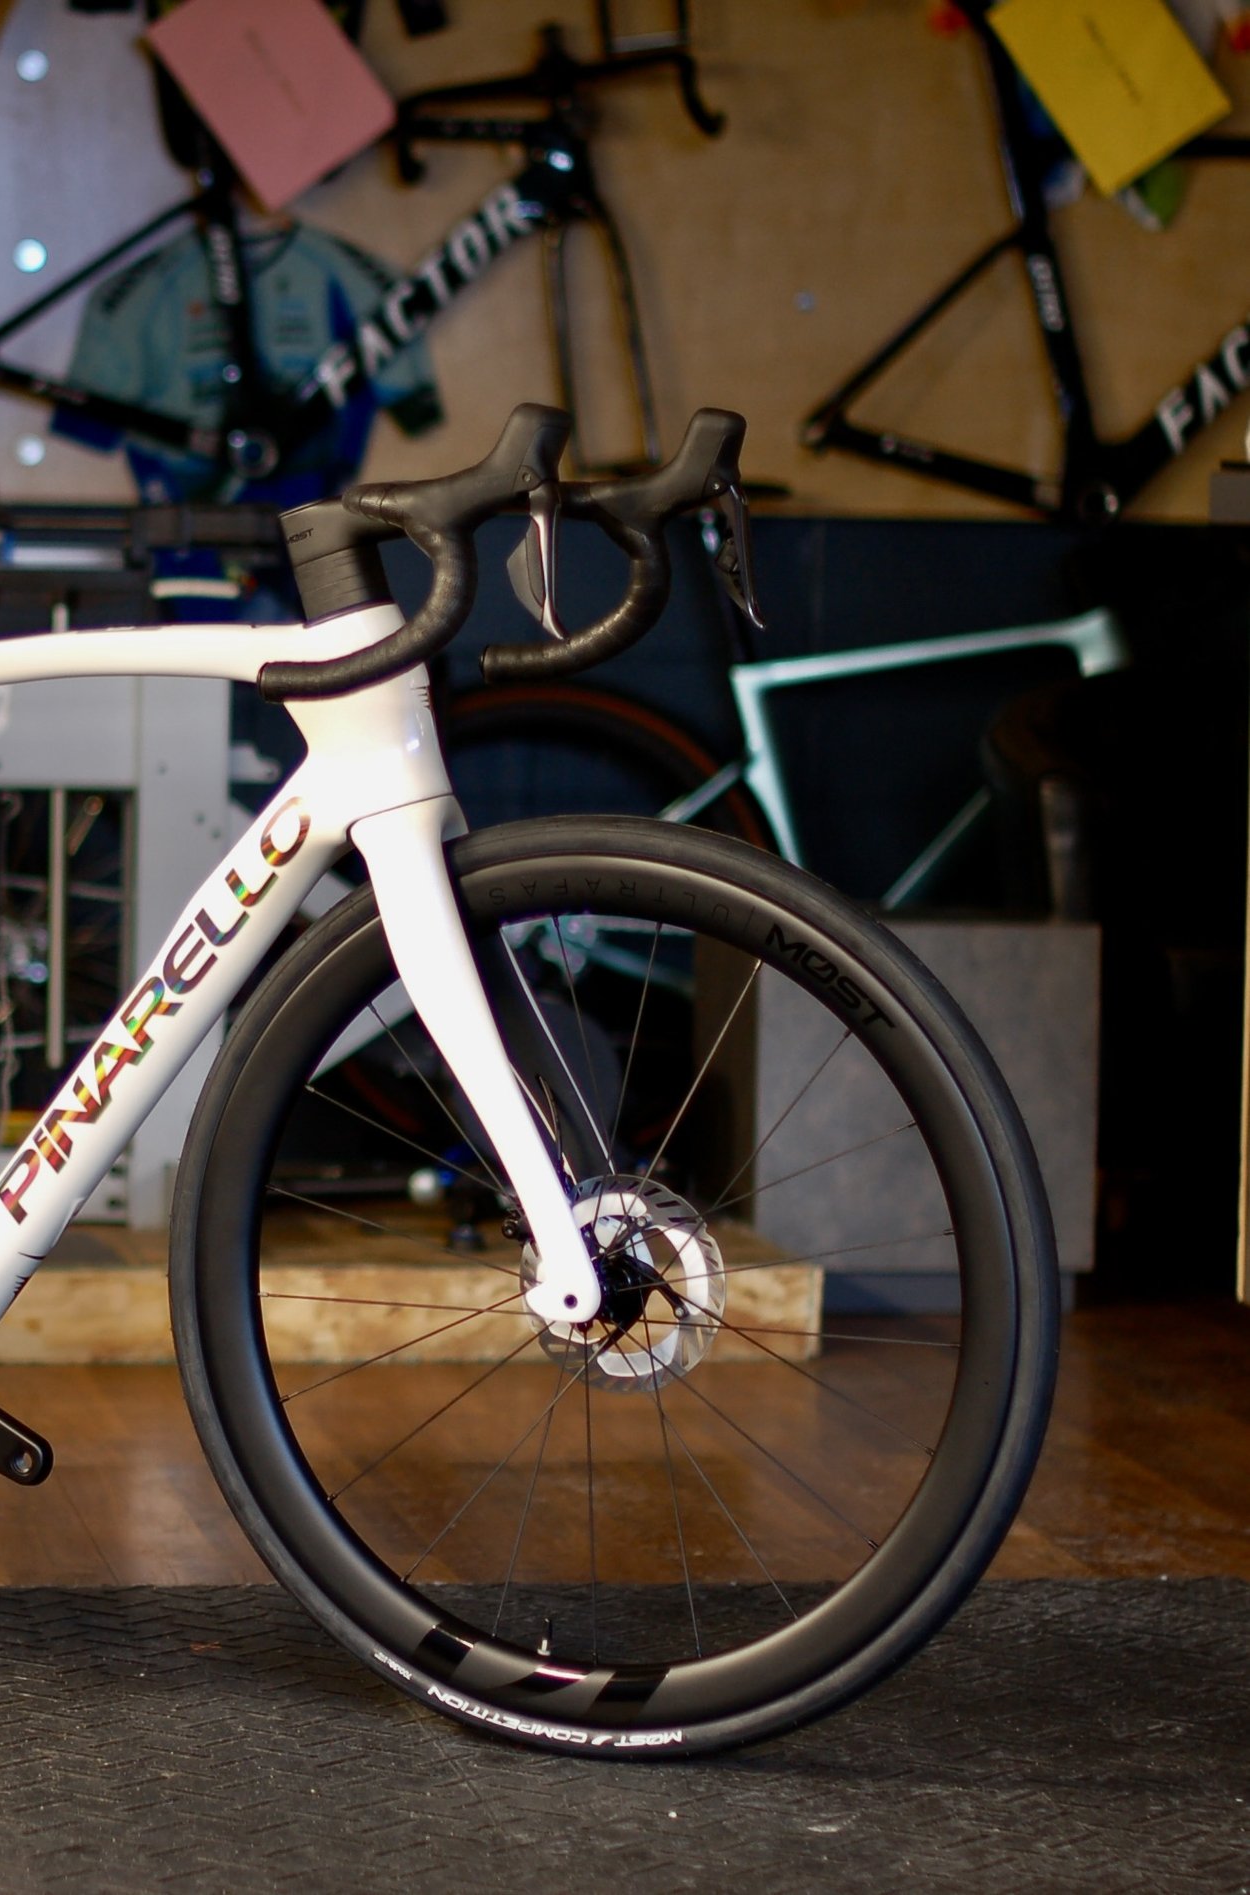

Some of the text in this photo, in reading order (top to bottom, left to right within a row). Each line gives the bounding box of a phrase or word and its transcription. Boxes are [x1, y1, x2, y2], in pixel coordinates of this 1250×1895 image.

[316, 184, 535, 407] FACTOR
[1156, 314, 1250, 455] FAC
[484, 876, 730, 922] ULTRAFAS
[428, 1686, 588, 1743] COMPETITION
